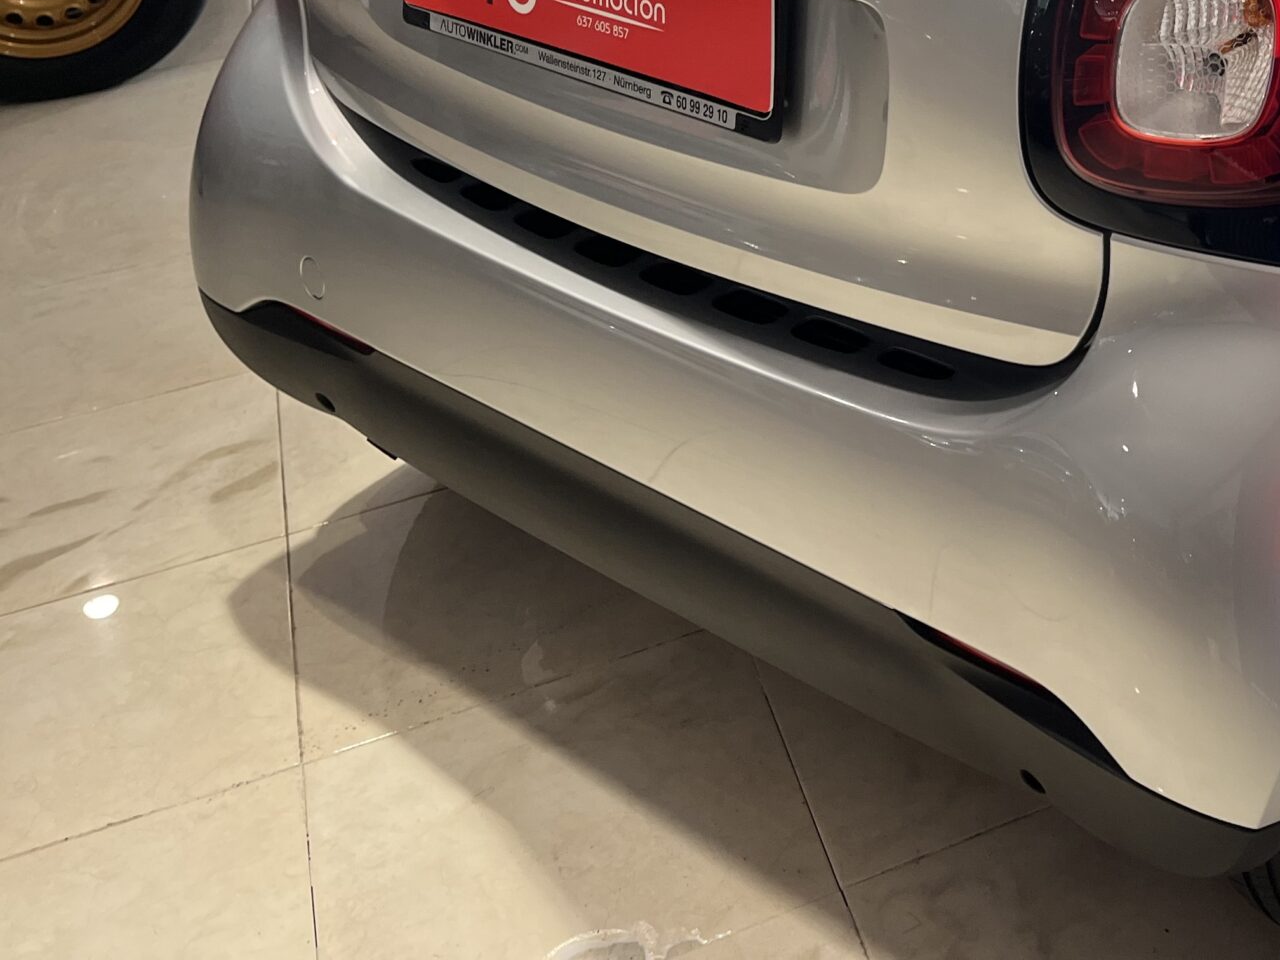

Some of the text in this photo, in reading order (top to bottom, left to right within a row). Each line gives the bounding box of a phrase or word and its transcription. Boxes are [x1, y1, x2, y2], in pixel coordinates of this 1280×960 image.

[576, 15, 629, 40] 637 605 857
[676, 95, 688, 111] 60
[689, 99, 701, 115] 99
[702, 103, 714, 120] 29
[717, 108, 728, 124] 10
